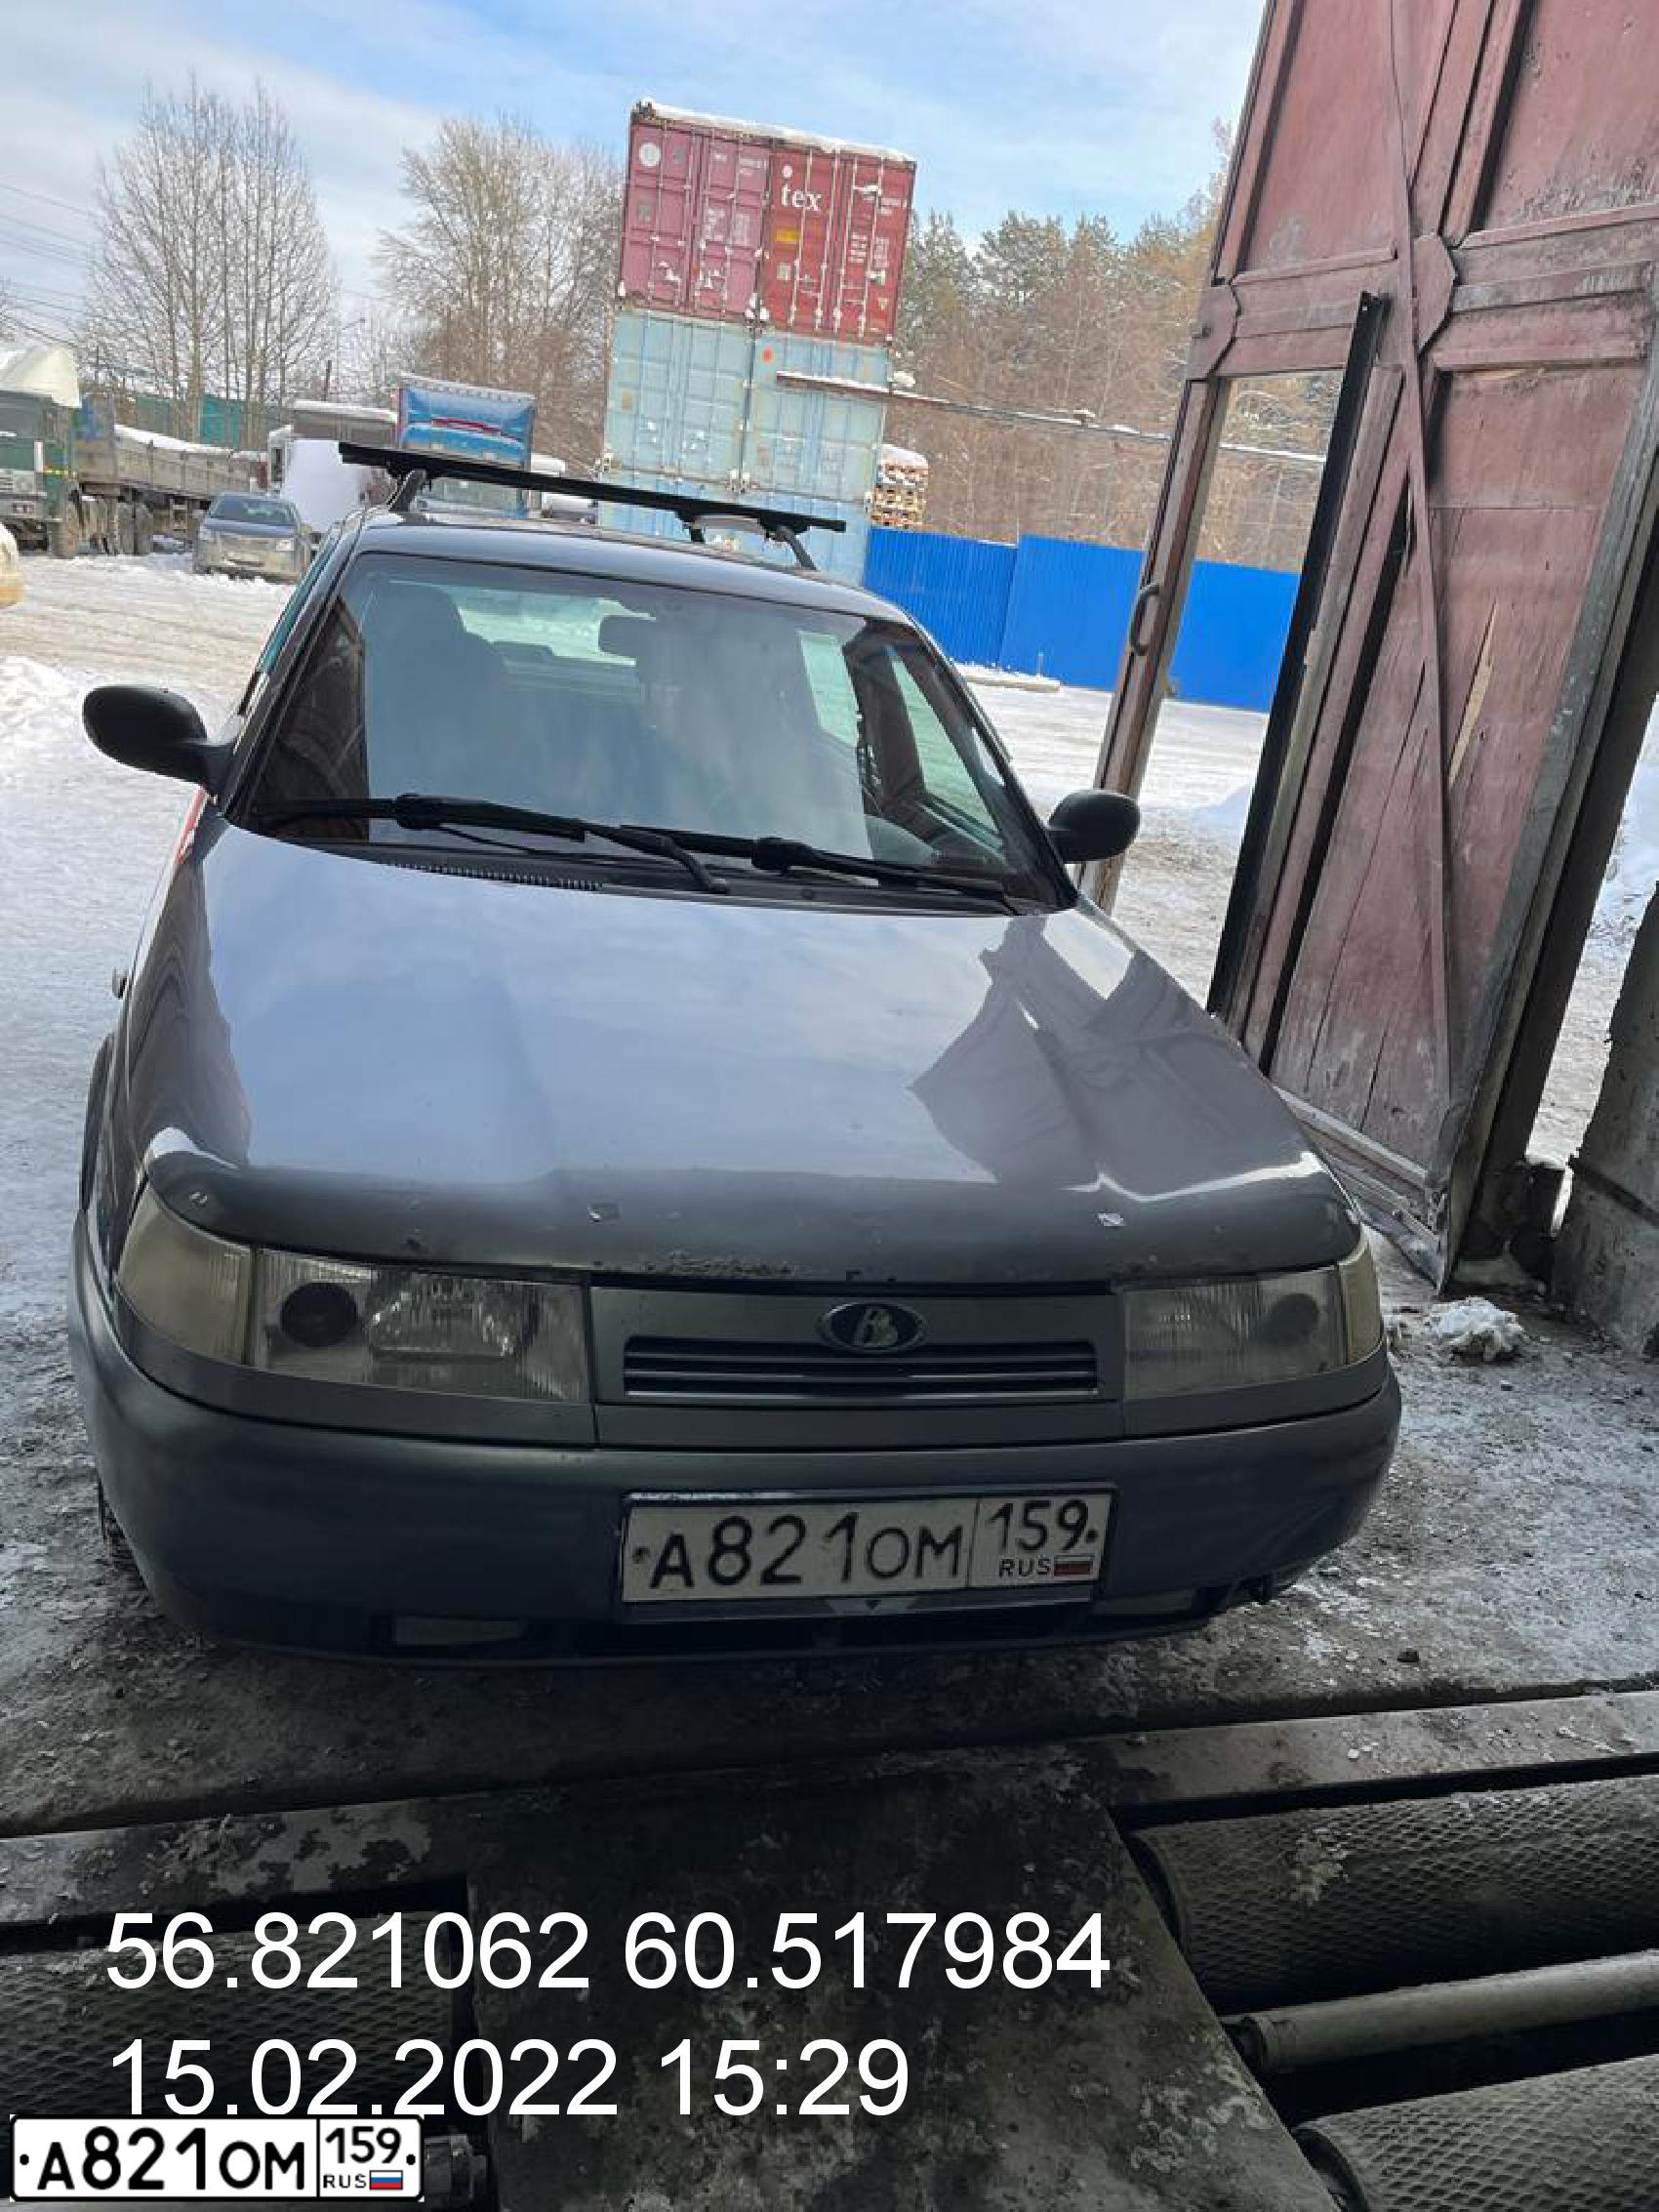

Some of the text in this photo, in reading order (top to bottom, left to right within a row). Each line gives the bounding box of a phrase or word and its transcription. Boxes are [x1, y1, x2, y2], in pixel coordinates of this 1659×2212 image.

[781, 184, 822, 212] tex
[984, 1499, 1089, 1552] 159
[997, 1557, 1052, 1577] RUS
